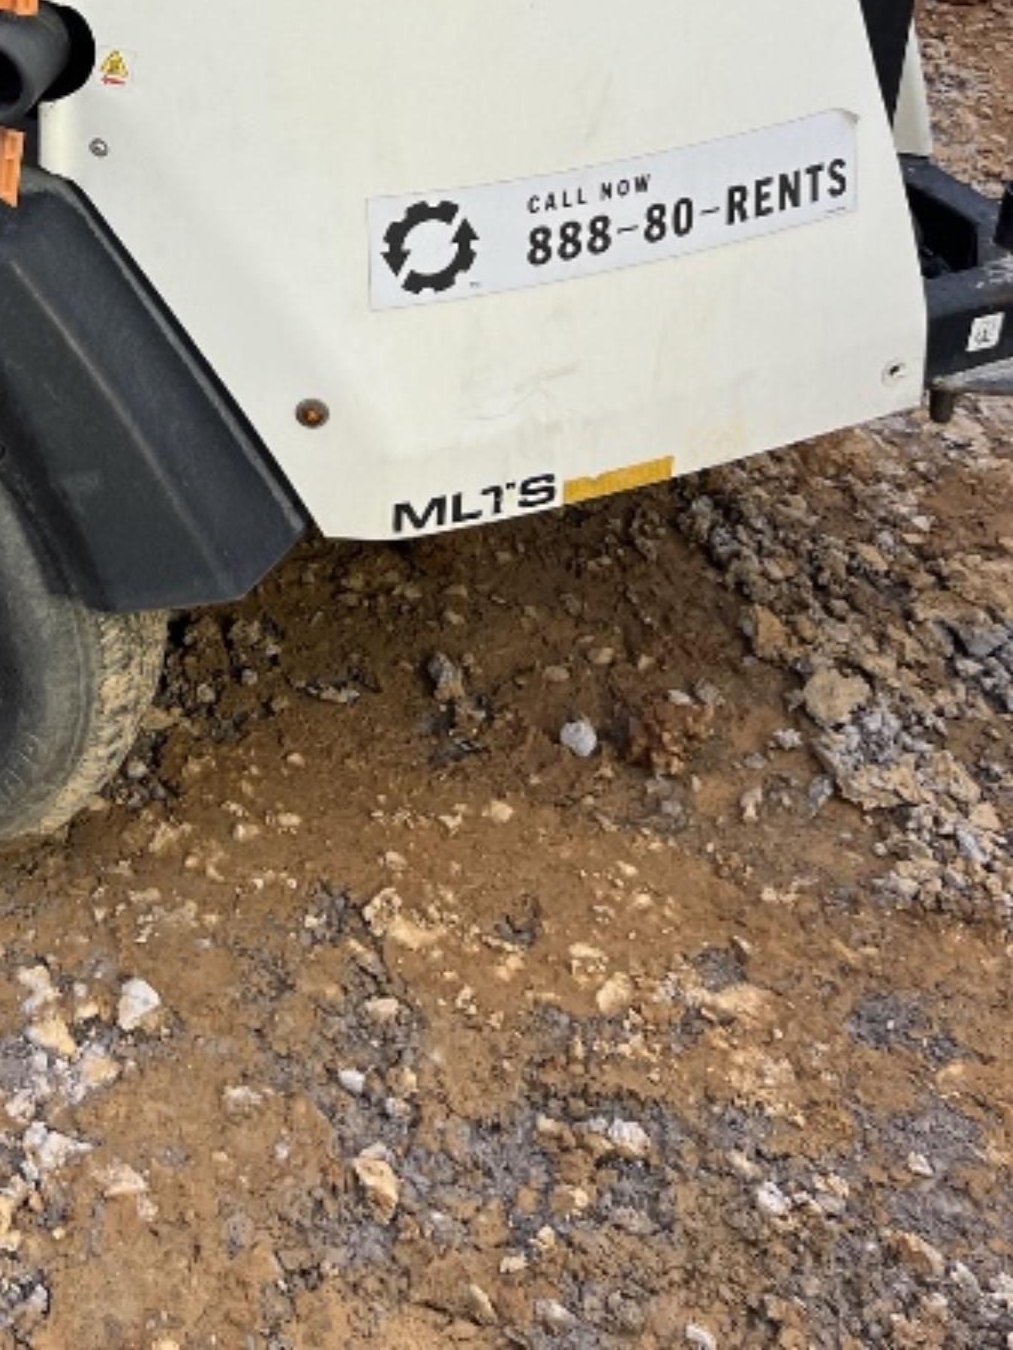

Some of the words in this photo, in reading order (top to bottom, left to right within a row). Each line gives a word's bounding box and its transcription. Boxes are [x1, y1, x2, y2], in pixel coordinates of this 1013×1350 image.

[526, 158, 847, 267] 888-80-RENTS
[527, 187, 588, 215] CALL
[600, 173, 652, 201] NOW
